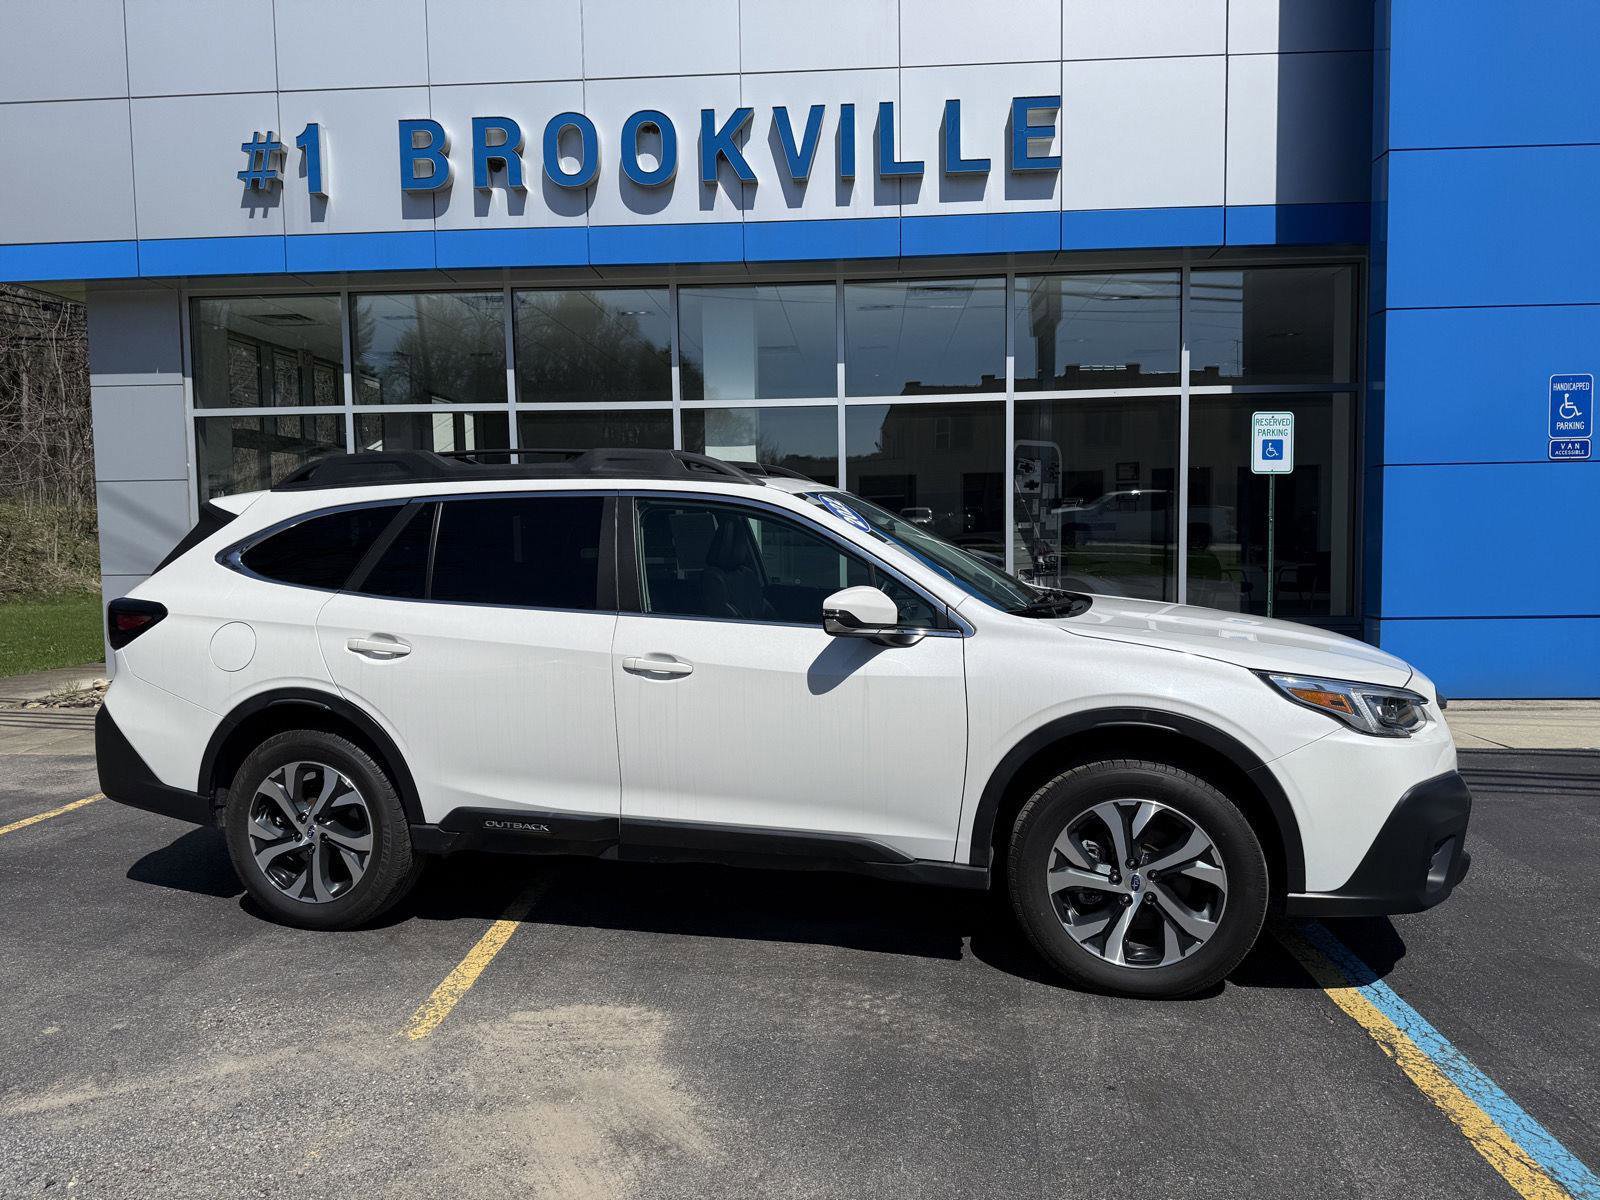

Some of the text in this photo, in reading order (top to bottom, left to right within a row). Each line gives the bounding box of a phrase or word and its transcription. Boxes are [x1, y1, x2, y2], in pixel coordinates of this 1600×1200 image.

[237, 95, 1062, 198] #1 BROOKVILLE
[1552, 382, 1590, 391] HANDICAPPED
[1255, 418, 1291, 427] RESERVED
[1556, 421, 1585, 430] PARKING
[1257, 428, 1289, 437] PARKING
[1560, 442, 1580, 450] VAN
[484, 820, 550, 832] OUTBACK
